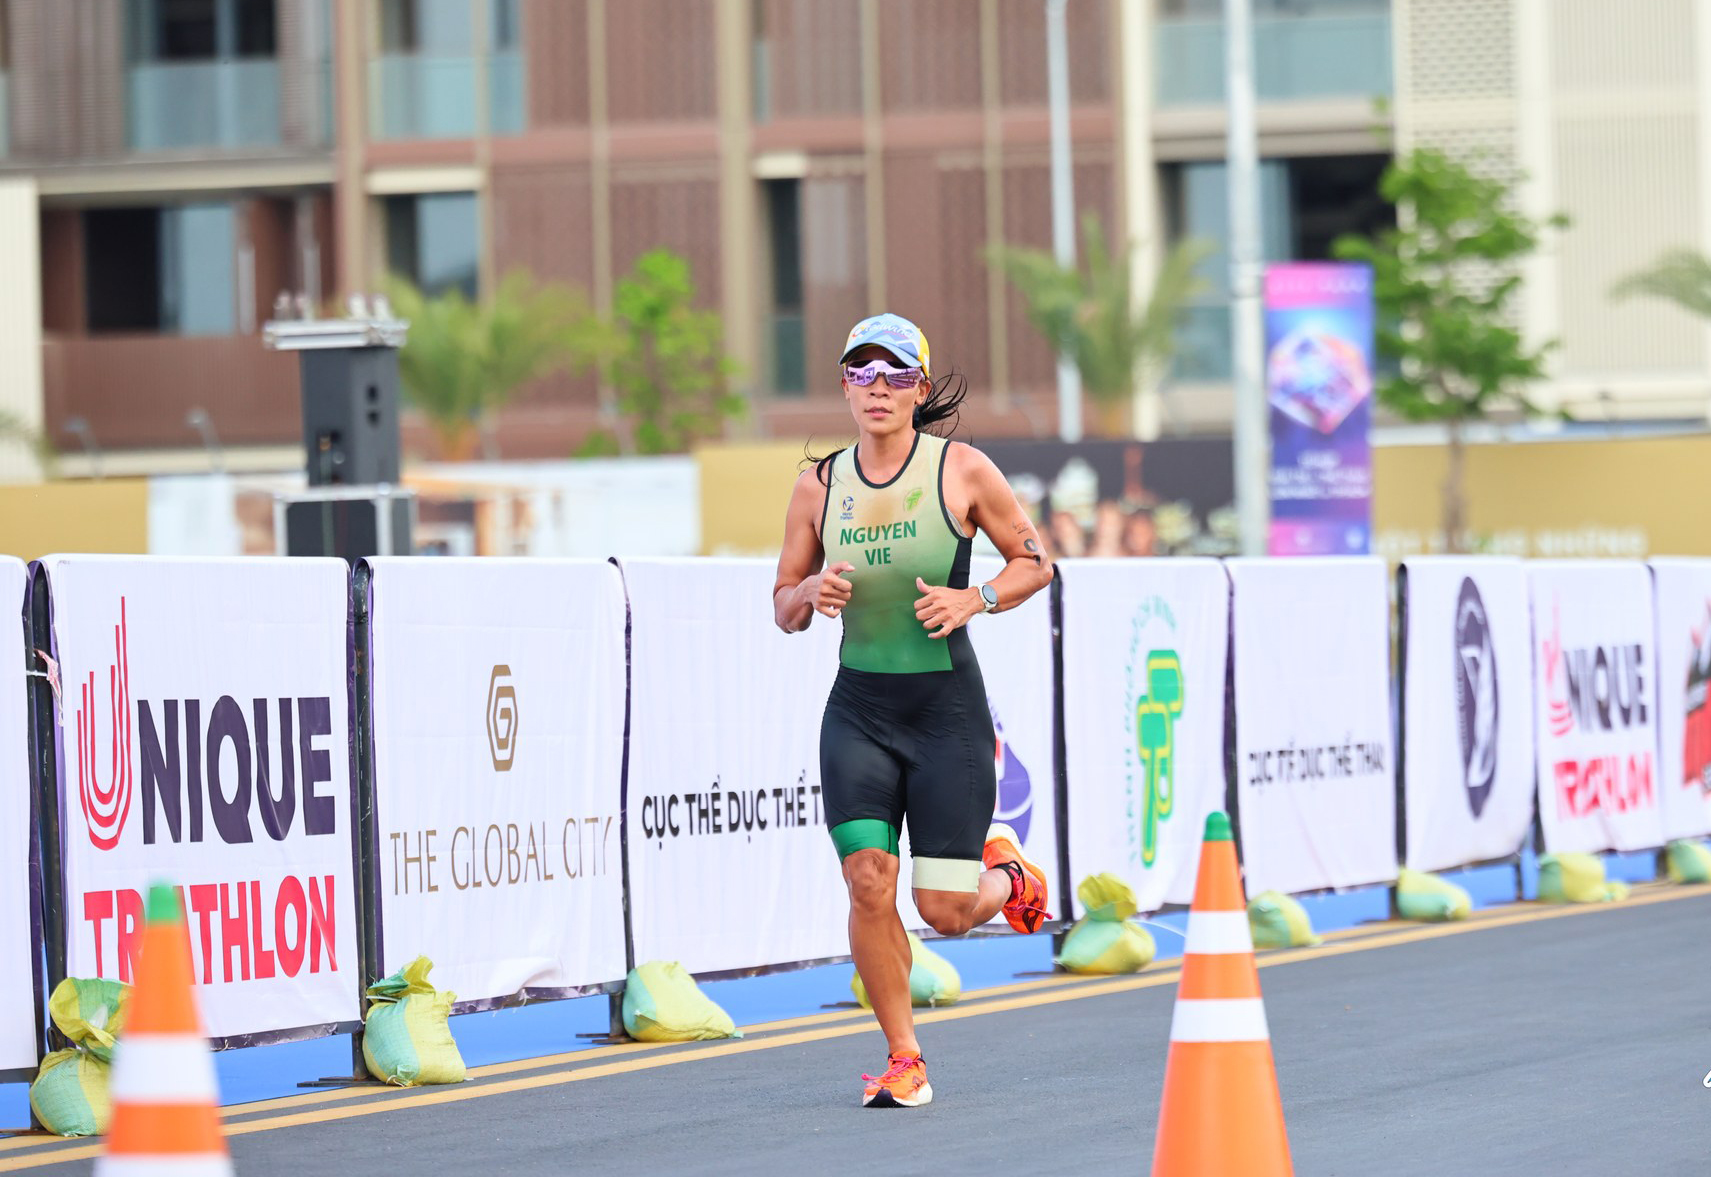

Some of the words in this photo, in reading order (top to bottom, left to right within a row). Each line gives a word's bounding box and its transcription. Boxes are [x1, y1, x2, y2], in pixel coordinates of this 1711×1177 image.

[840, 520, 916, 546] NGUYEN
[865, 547, 891, 566] VIE
[77, 596, 336, 851] UNIQUE
[642, 794, 680, 850] CỤC
[684, 774, 722, 835] THỂ
[727, 788, 768, 843] DỤC
[772, 769, 807, 828] THỂ
[390, 830, 439, 895] THE
[451, 821, 553, 890] GLOBAL
[563, 816, 613, 879] CITY
[84, 875, 338, 985] TRTHLON
